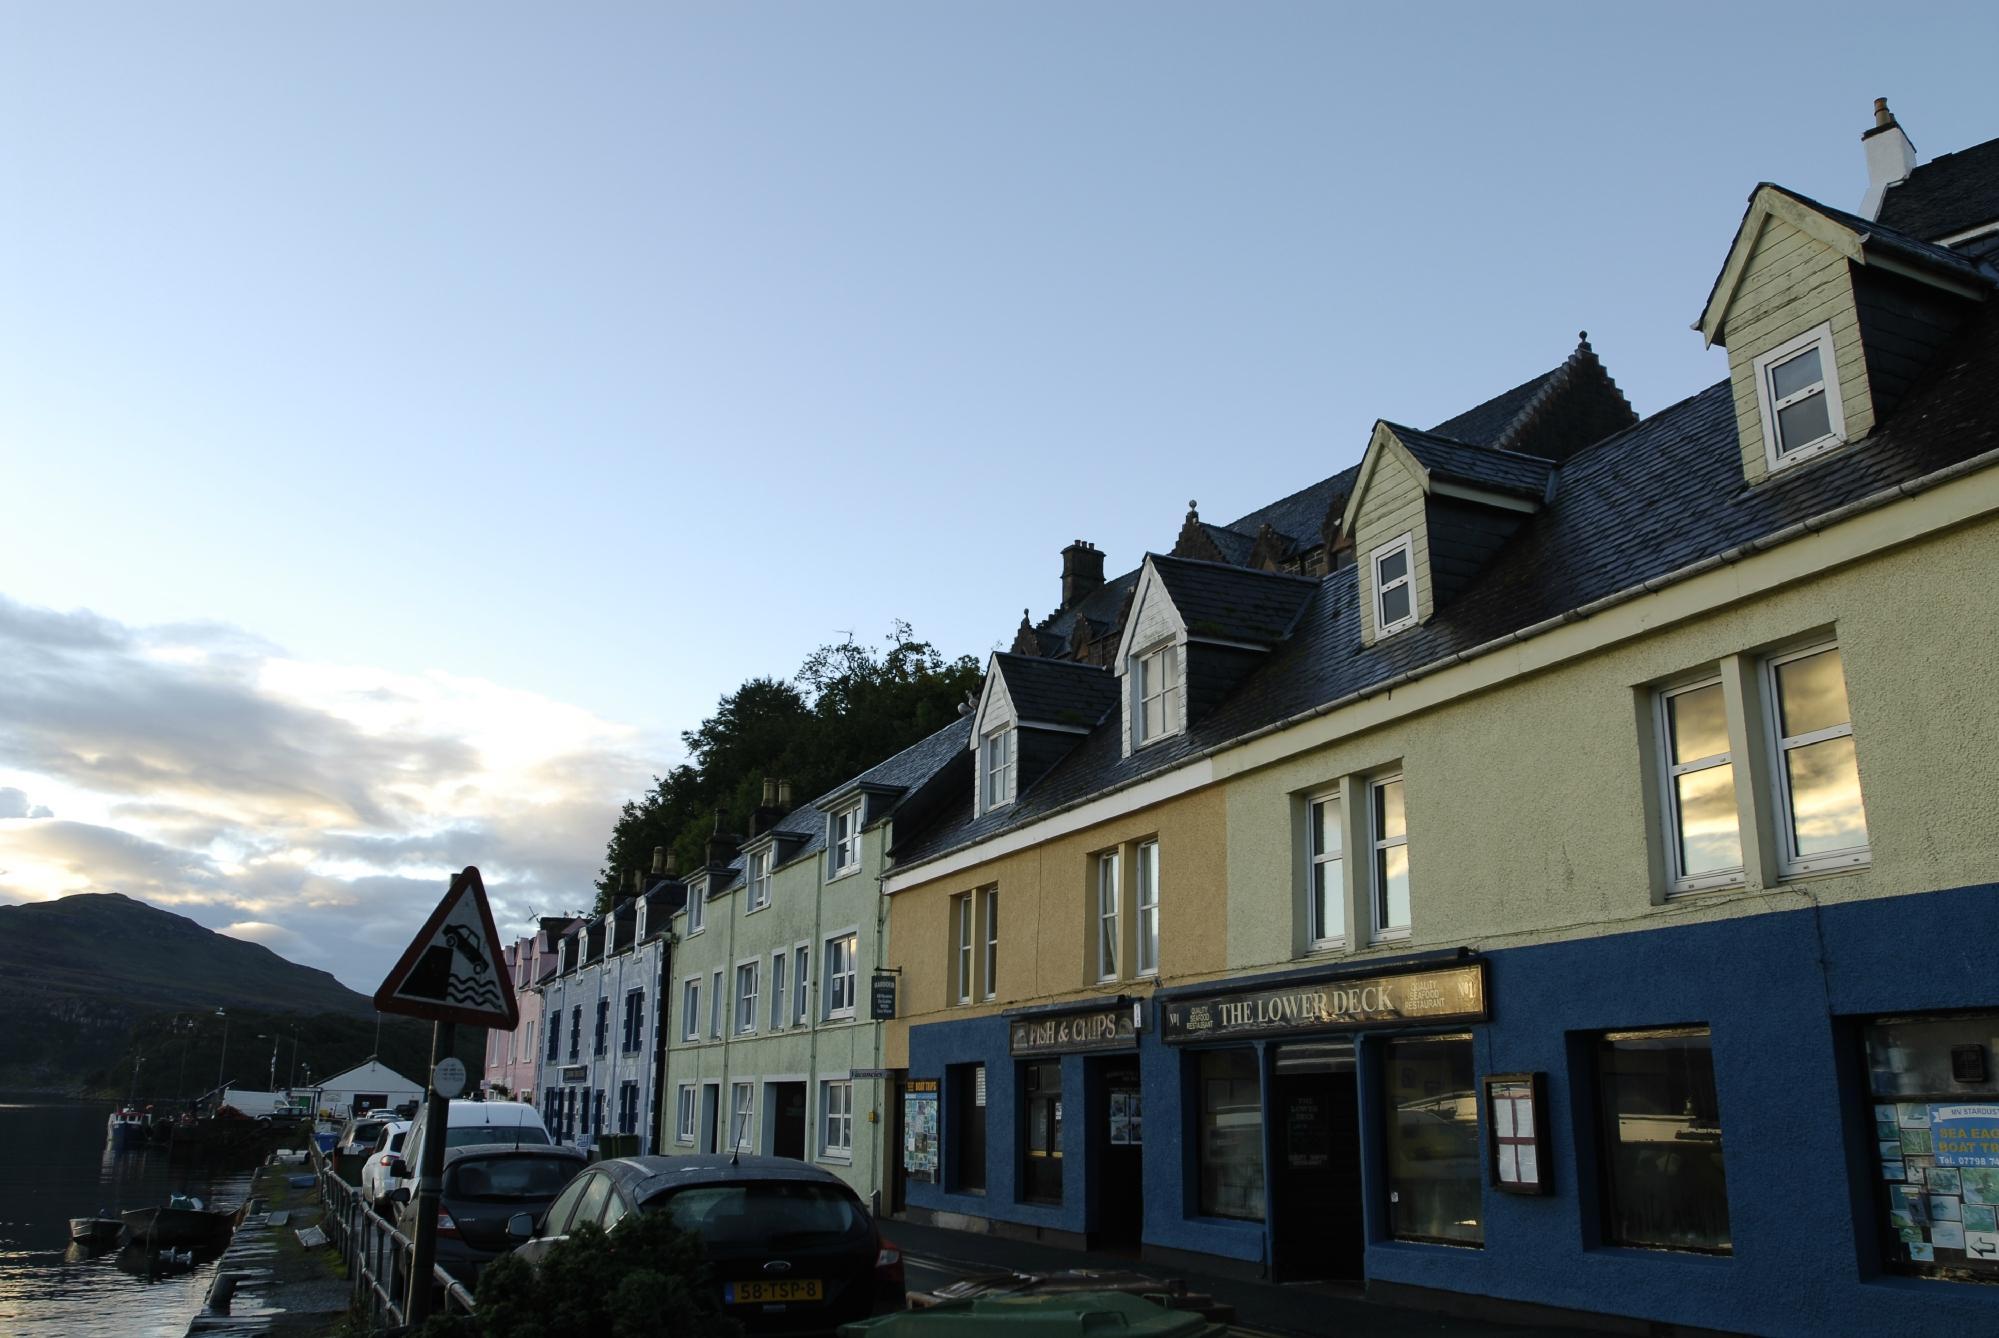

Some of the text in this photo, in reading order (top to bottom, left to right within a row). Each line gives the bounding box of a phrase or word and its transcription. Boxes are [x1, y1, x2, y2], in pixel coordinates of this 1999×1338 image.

[1410, 980, 1438, 991] QUALITY
[1409, 989, 1440, 1000] SEAFOOD
[1218, 985, 1395, 1026] THE LOWER DECK
[1404, 998, 1445, 1010] RESTAURANT
[1030, 1021, 1056, 1045] FISH
[1058, 1021, 1070, 1042] &
[1073, 1014, 1116, 1041] CHIPS
[1186, 1020, 1214, 1030] RESTAURANT
[1939, 1128, 1967, 1138] SEA
[1939, 1142, 1976, 1153] BOAT
[1958, 1156, 1986, 1165] 07798
[740, 1281, 816, 1300] 58-TSP-8
